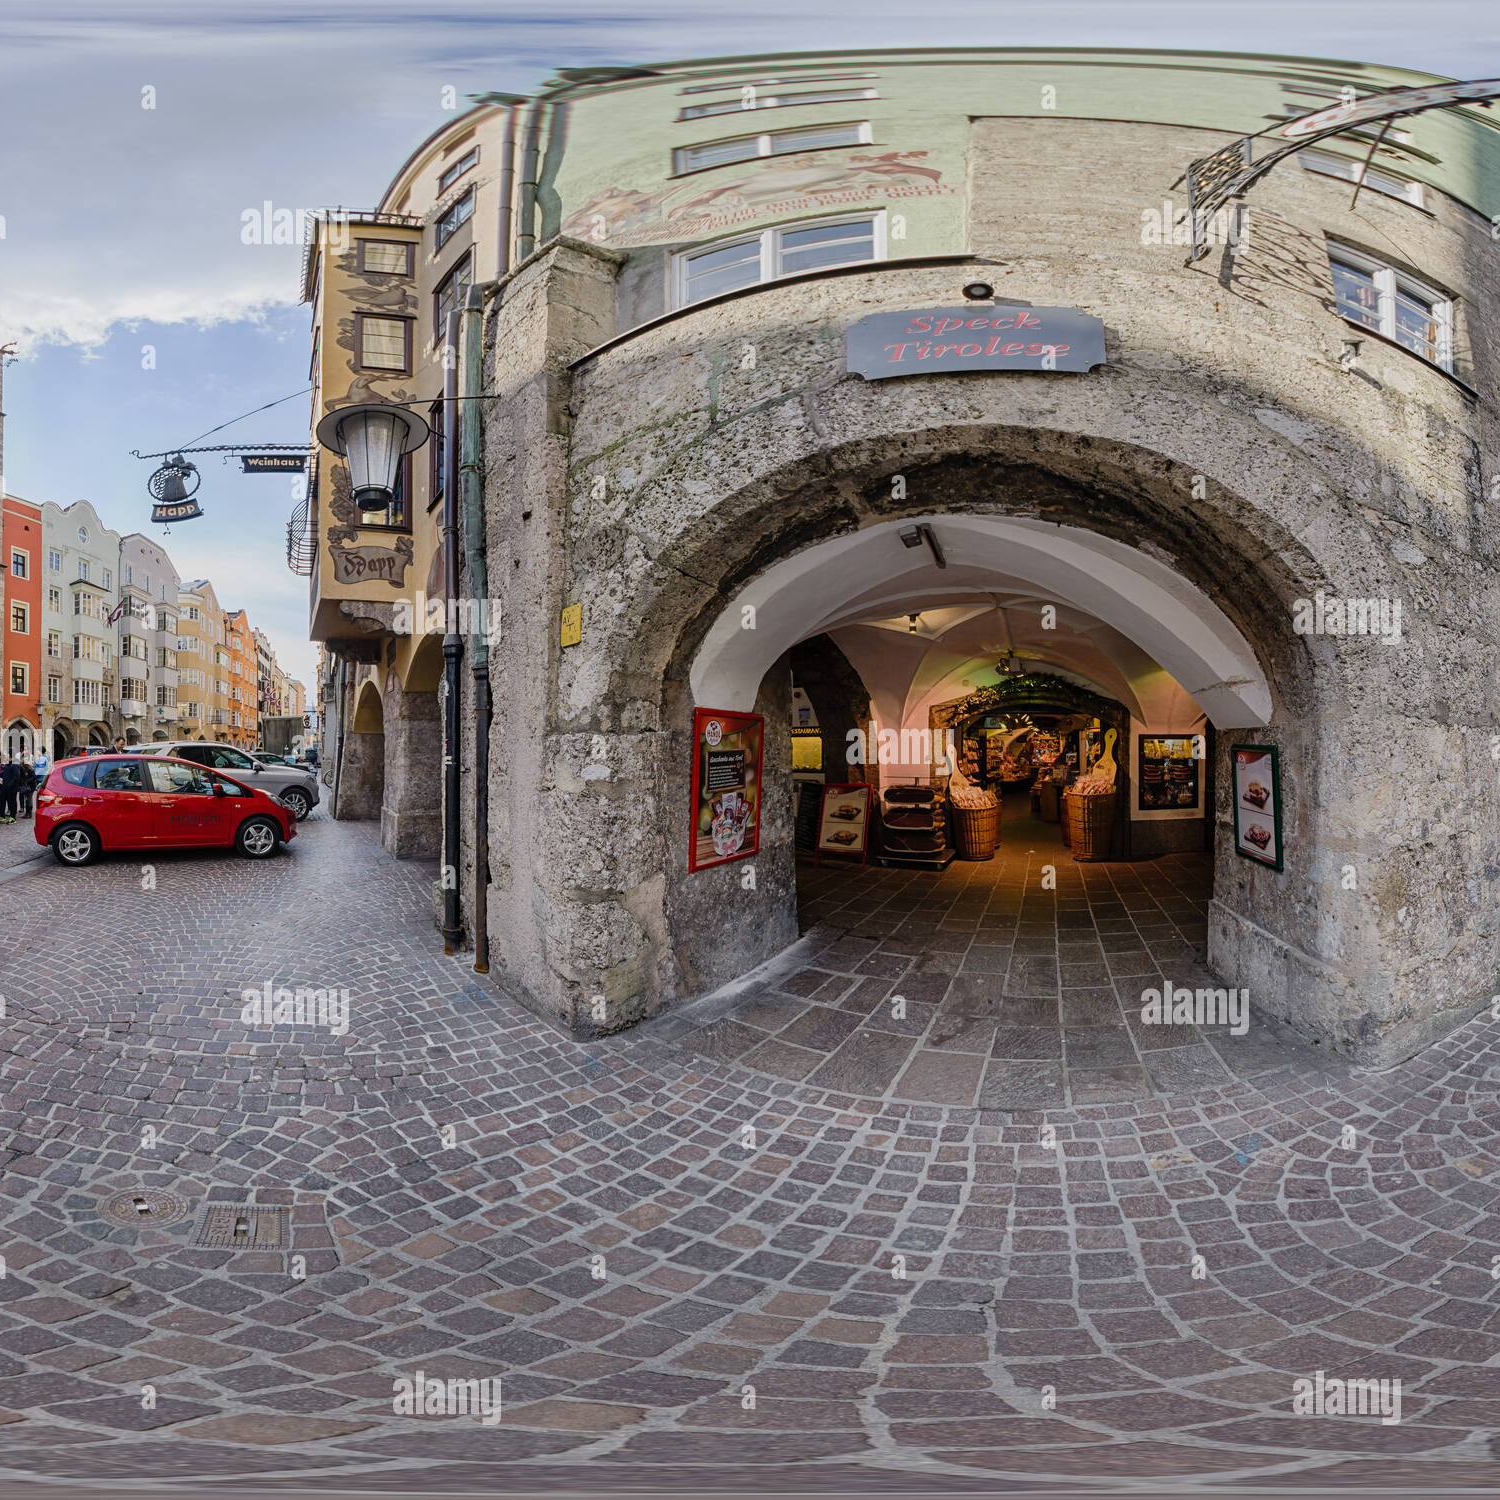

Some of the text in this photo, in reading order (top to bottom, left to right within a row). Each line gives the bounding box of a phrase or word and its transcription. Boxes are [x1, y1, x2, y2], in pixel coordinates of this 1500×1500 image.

[907, 311, 1042, 336] Speck
[884, 336, 1070, 363] Tirolese
[247, 456, 301, 467] Weinhaus
[156, 503, 195, 517] Happ
